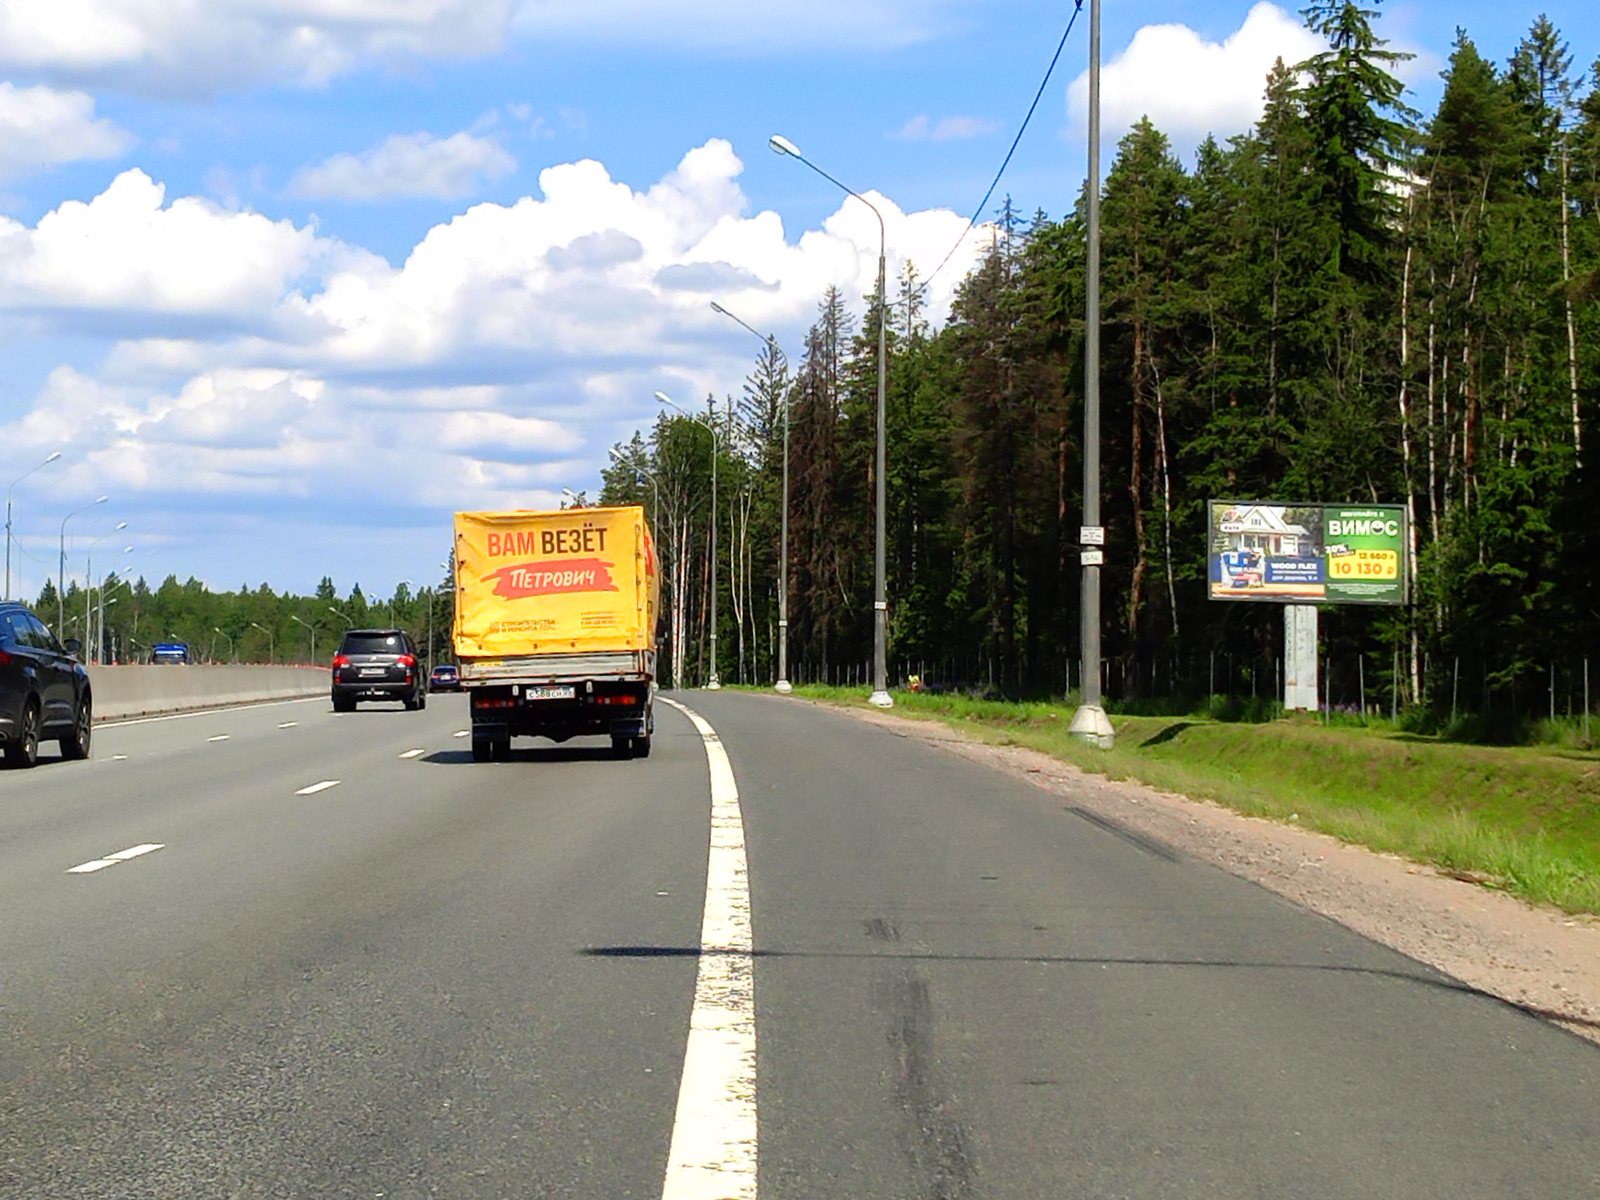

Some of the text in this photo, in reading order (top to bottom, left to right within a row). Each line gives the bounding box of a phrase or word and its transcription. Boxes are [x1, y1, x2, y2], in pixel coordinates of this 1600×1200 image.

[1328, 520, 1398, 536] ВИМОС
[487, 522, 608, 557] ВАМ ВЕЗЁТ
[1334, 562, 1352, 575] 10
[1357, 562, 1383, 575] 130
